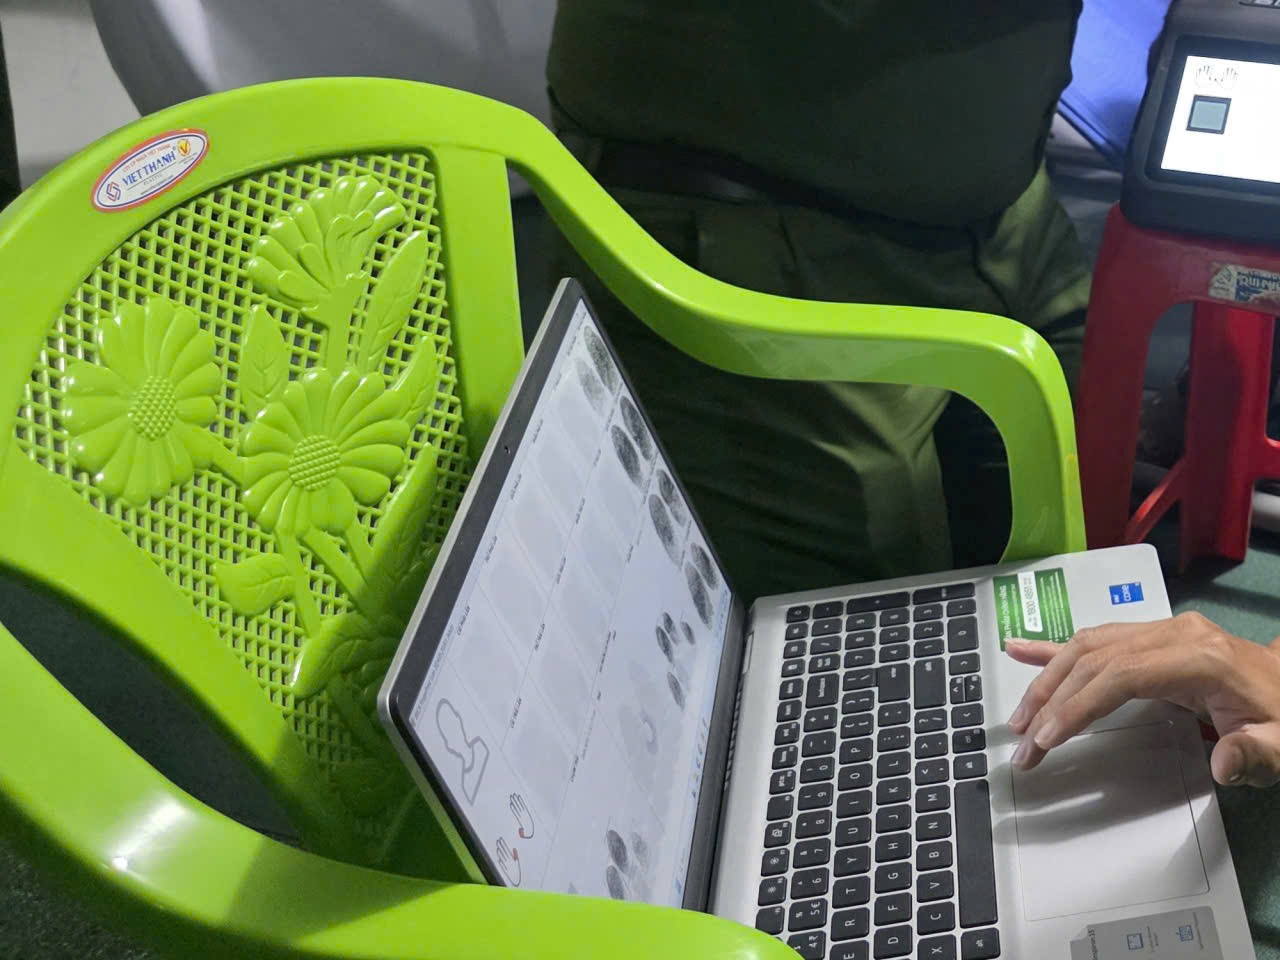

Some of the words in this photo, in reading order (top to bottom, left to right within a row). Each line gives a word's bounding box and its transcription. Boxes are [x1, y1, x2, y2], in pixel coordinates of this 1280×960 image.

[928, 793, 937, 801] M
[930, 881, 940, 889] V
[932, 946, 942, 954] X
